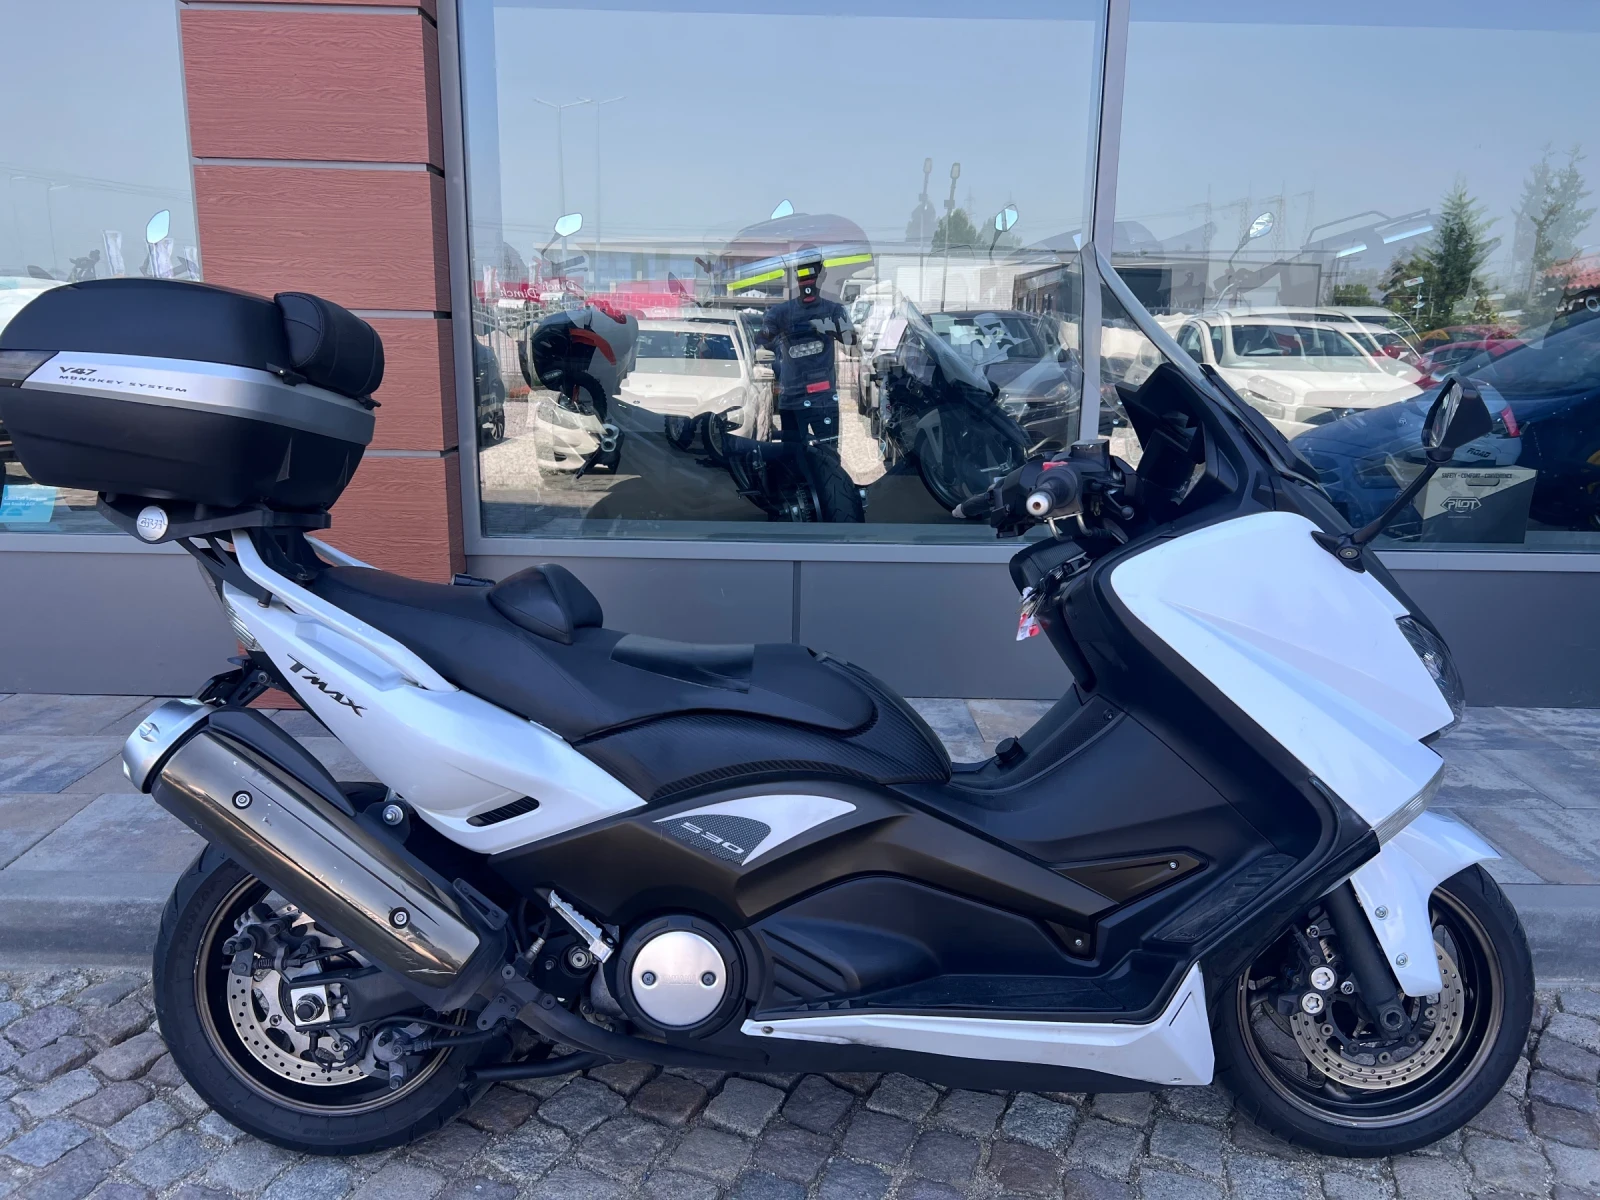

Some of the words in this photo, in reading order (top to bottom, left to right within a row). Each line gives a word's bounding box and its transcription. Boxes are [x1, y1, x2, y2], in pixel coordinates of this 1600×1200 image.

[60, 366, 97, 376] V47
[59, 375, 124, 385] MONOKEY
[129, 382, 187, 393] SYSTEM
[1466, 447, 1491, 458] ROAD
[286, 653, 368, 718] TMAX
[680, 821, 745, 854] 530
